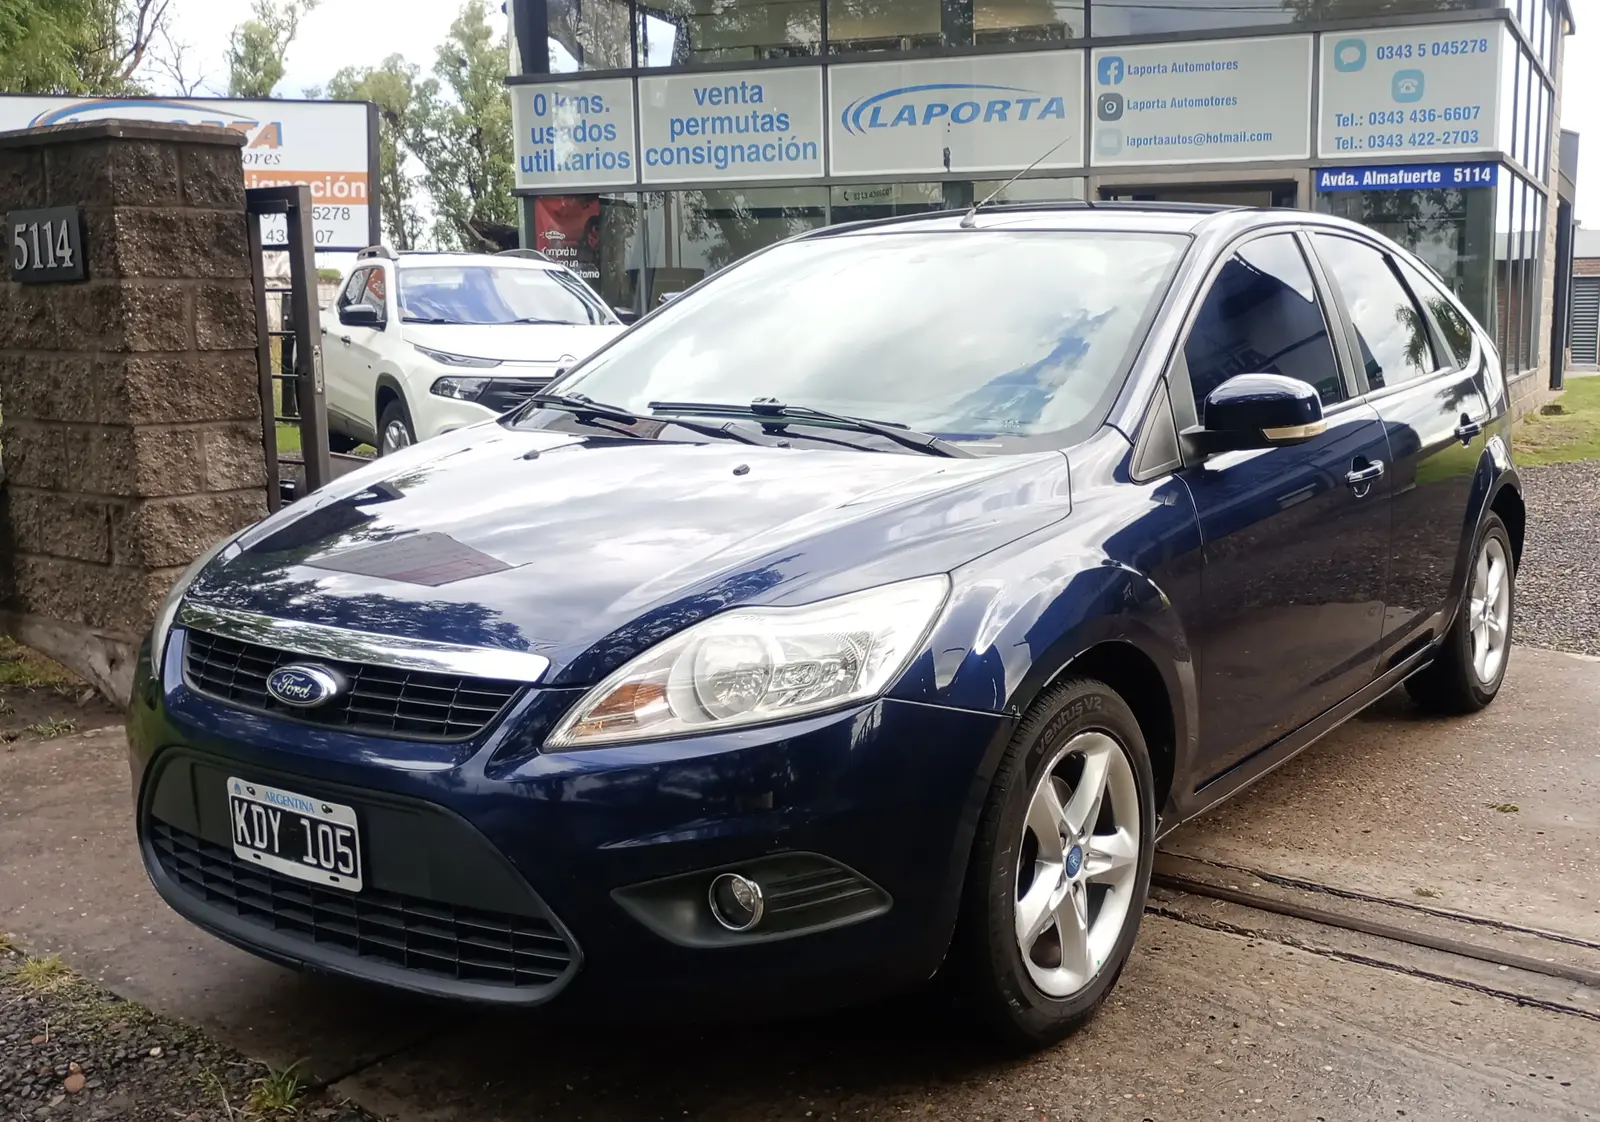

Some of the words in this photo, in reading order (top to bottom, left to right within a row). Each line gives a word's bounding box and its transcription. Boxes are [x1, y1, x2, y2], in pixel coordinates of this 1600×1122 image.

[1376, 44, 1412, 60] 0343
[1418, 43, 1426, 57] 5
[1431, 38, 1488, 57] 045278
[1127, 63, 1168, 77] Laporta
[1171, 60, 1238, 74] Automotores
[533, 93, 547, 117] 0
[693, 81, 763, 106] venta
[1127, 98, 1167, 112] Laporta
[1170, 95, 1238, 109] Automotores
[868, 96, 1066, 129] LAPORTA
[1335, 112, 1364, 127] Tel.:
[1368, 111, 1404, 126] 0343
[1409, 105, 1480, 123] 436-6607
[530, 119, 617, 145] usados
[669, 110, 790, 143] permutas
[1126, 131, 1273, 148] laportaautos@hotmail.com
[1335, 134, 1363, 150] Tel.:
[1368, 133, 1404, 148] 0343
[1408, 130, 1479, 147] 422-2703
[520, 146, 631, 173] utiltarios
[645, 136, 818, 170] consignación
[1321, 171, 1359, 187] Avda.
[1362, 169, 1441, 186] Almafuerte
[1453, 167, 1491, 183] 5114
[14, 219, 74, 271] 5114
[277, 673, 312, 699] Ford
[264, 791, 315, 813] ARGENTINA
[234, 799, 281, 854] KDY
[300, 818, 354, 875] 105
